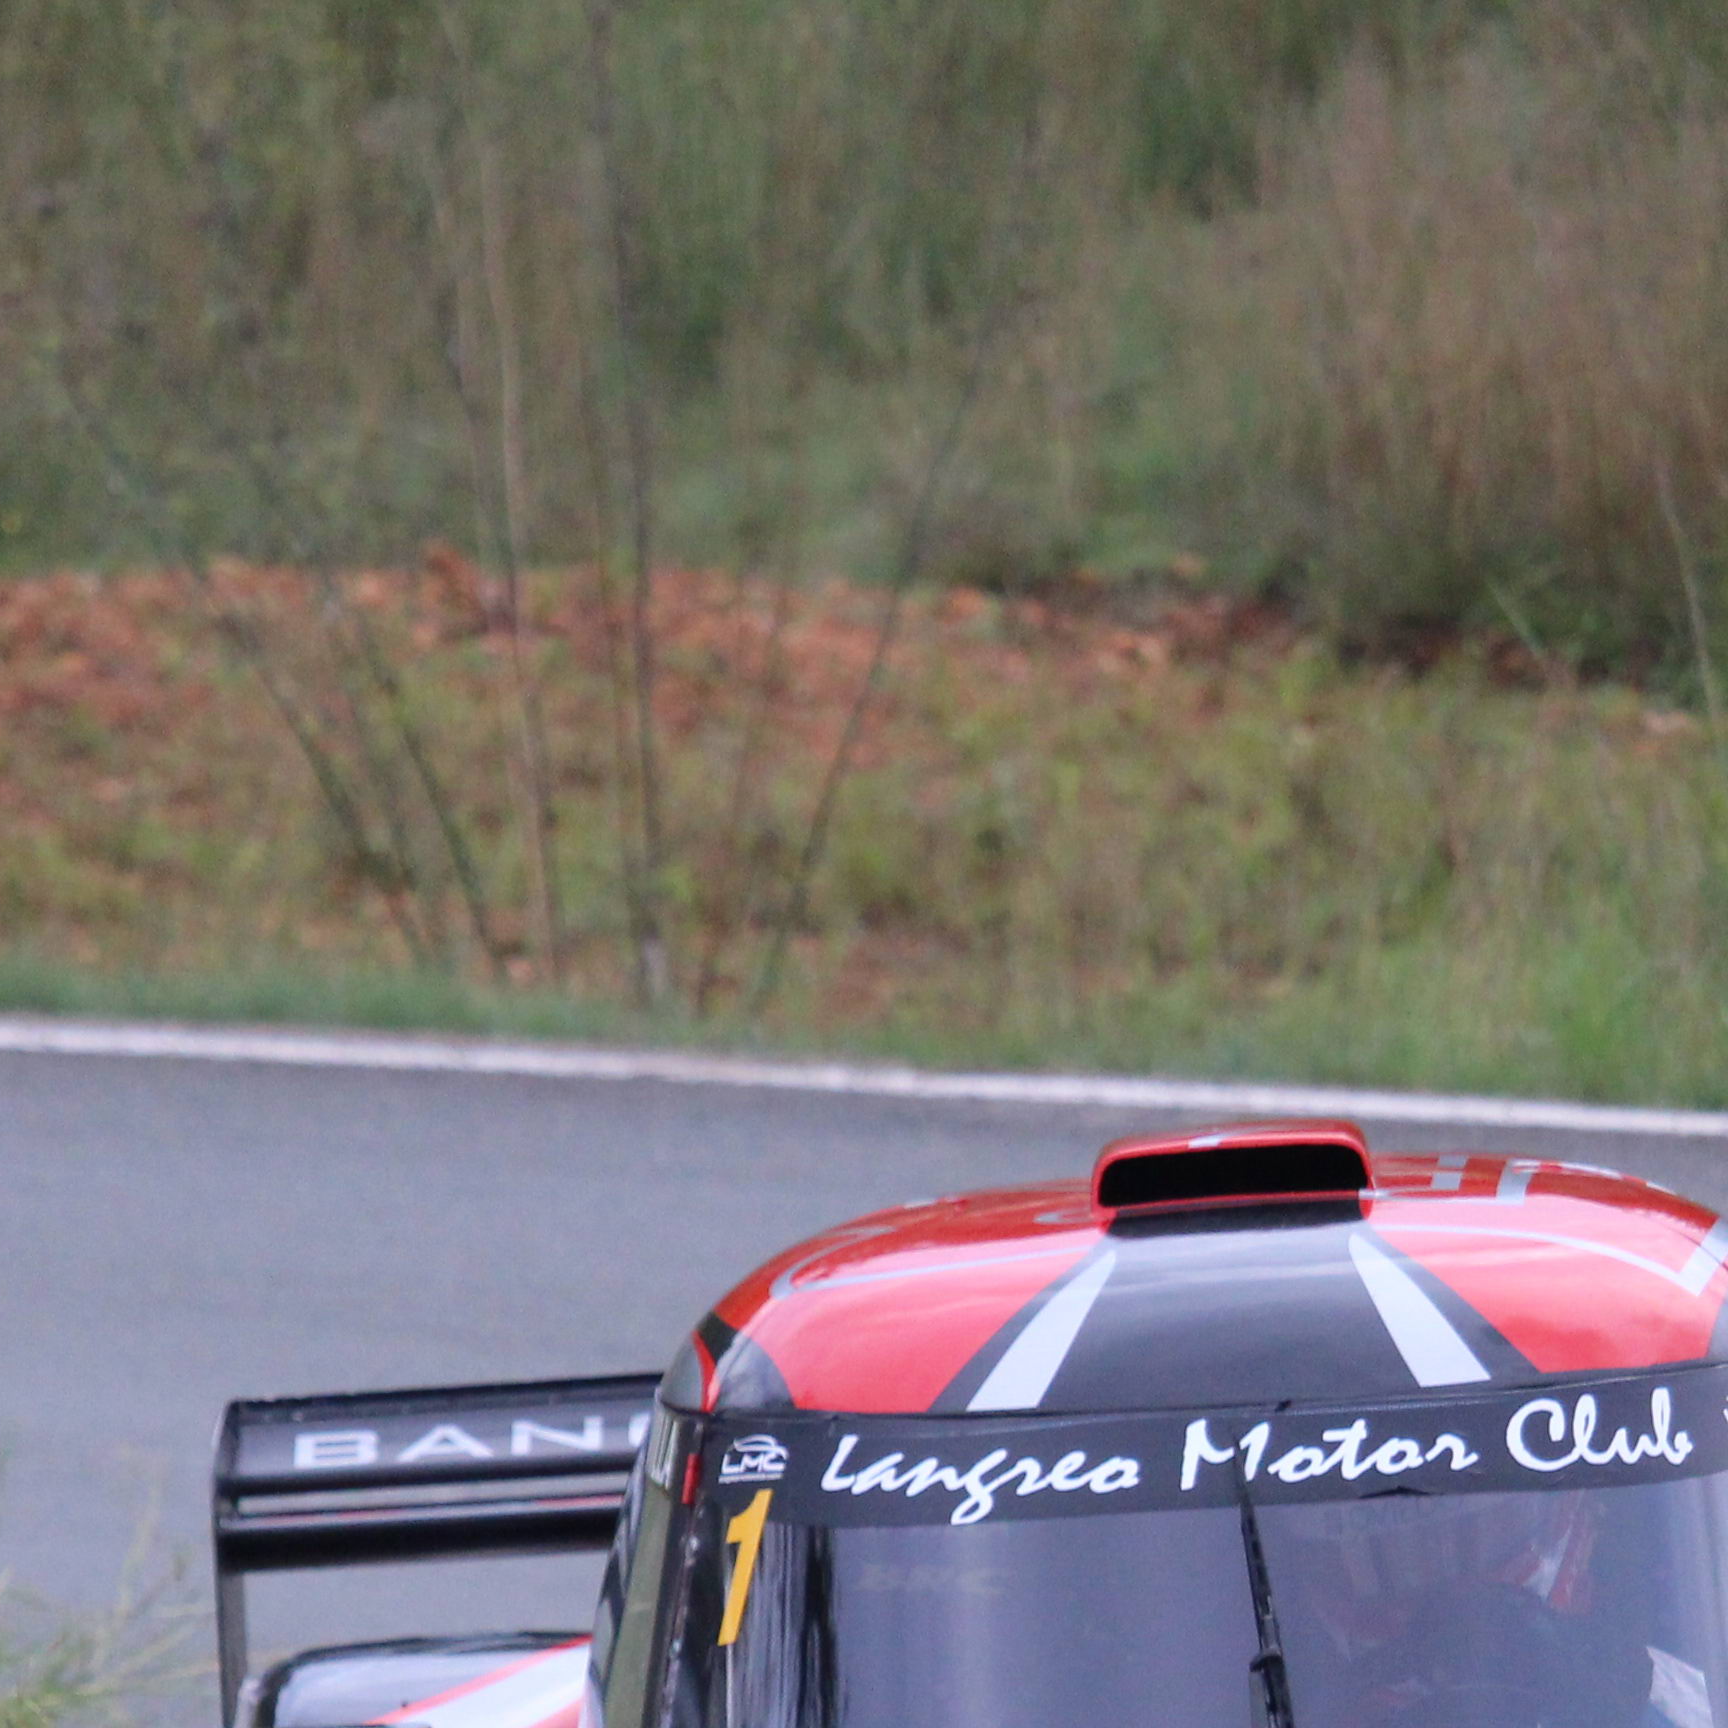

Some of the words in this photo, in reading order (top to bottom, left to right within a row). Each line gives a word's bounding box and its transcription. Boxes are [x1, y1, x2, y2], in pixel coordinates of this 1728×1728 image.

[820, 1434, 1141, 1526] Langreo
[1179, 1418, 1479, 1491] Motor
[1505, 1386, 1694, 1472] Club
[718, 1489, 774, 1646] 1
